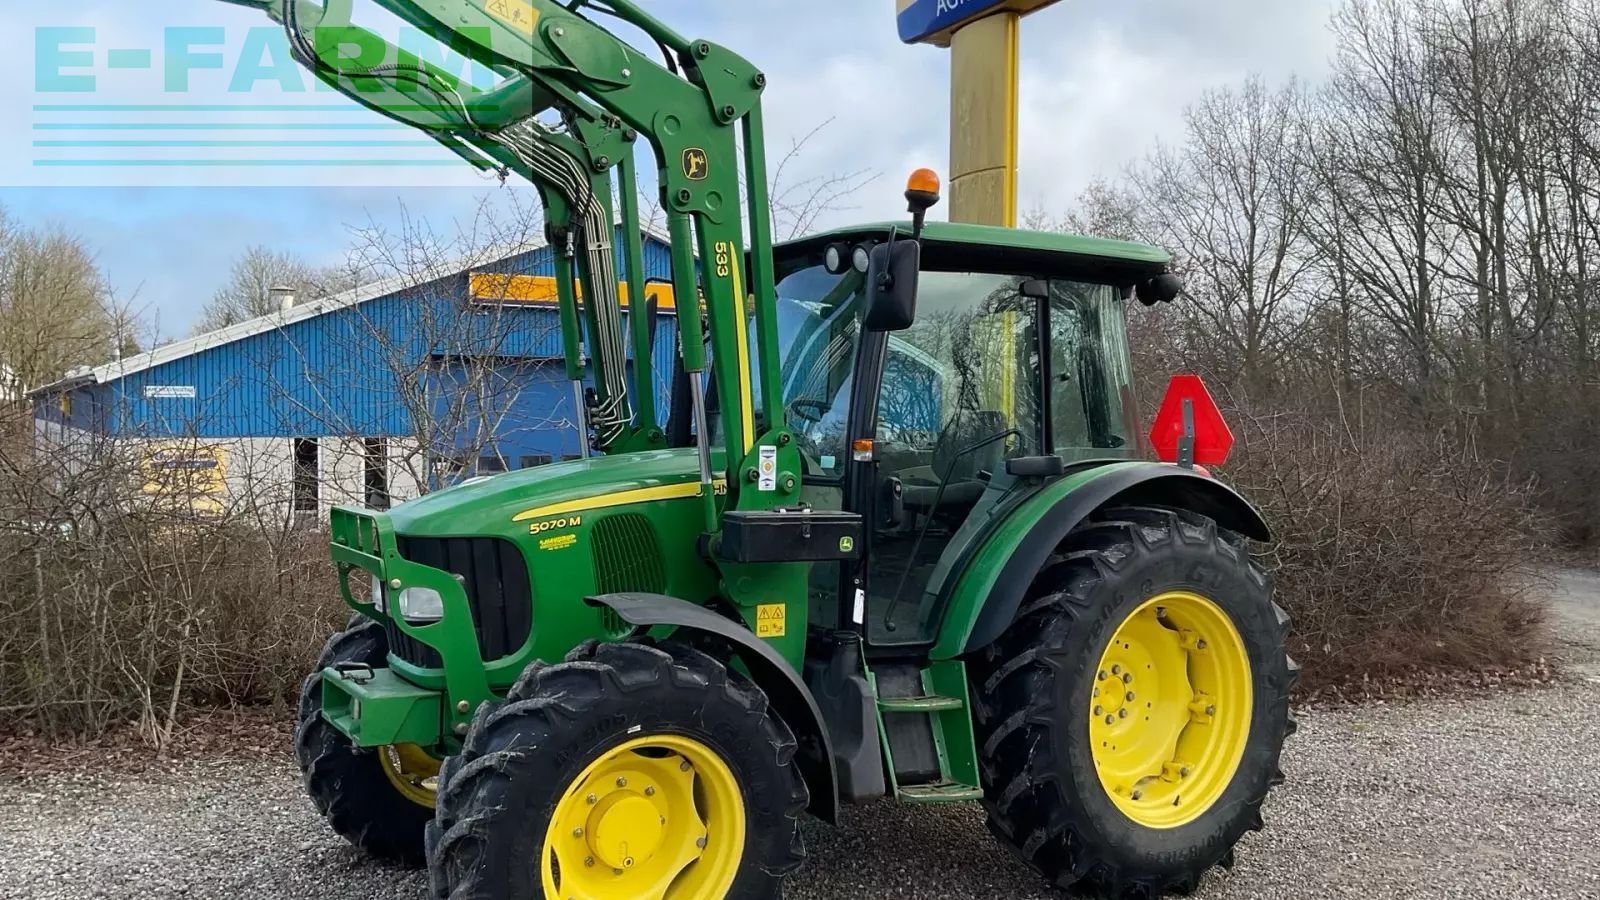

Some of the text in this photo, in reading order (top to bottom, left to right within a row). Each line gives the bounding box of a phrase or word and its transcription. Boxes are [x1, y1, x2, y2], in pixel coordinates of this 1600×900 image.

[715, 241, 729, 277] 533
[529, 516, 581, 535] 5070 M
